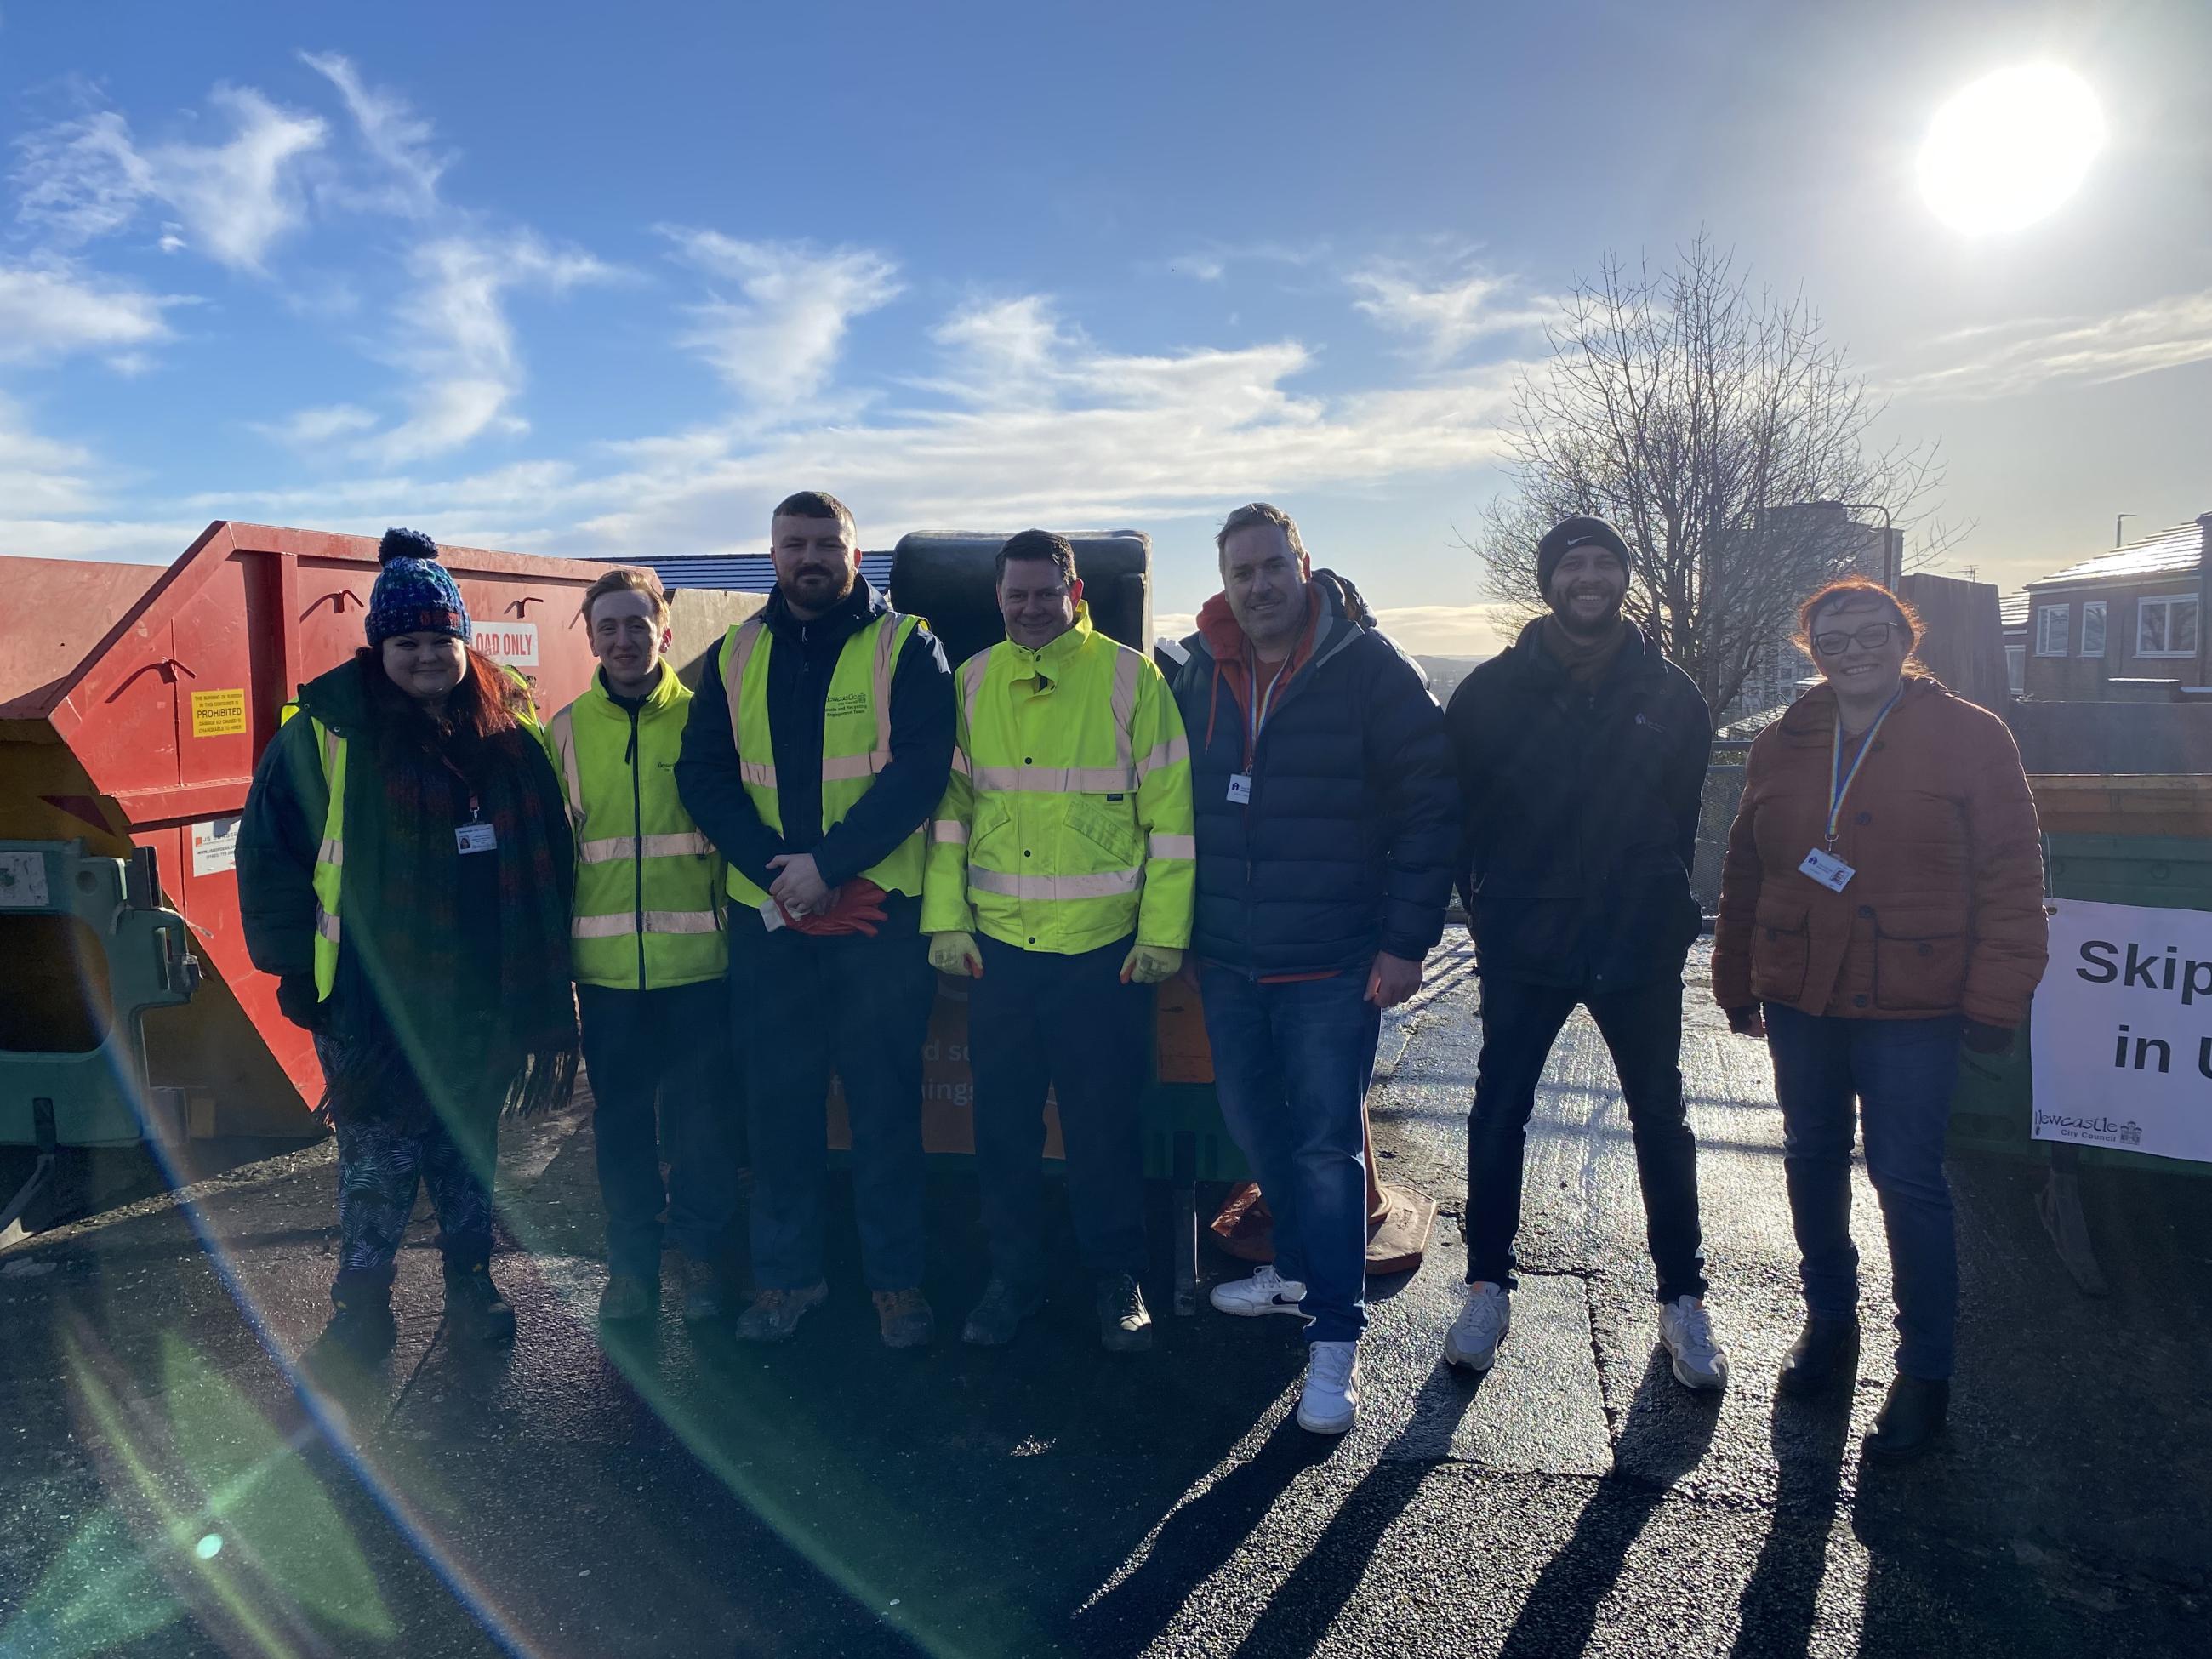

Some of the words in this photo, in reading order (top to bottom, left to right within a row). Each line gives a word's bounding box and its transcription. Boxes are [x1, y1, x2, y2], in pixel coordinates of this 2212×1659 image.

[476, 633, 499, 655] OAD
[504, 633, 532, 655] ONLY
[197, 708, 241, 718] PROHIBITED
[2115, 1024, 2171, 1073] in
[2035, 1109, 2118, 1132] Newcastle
[2061, 1129, 2078, 1138] City
[2081, 1131, 2116, 1143] Council
